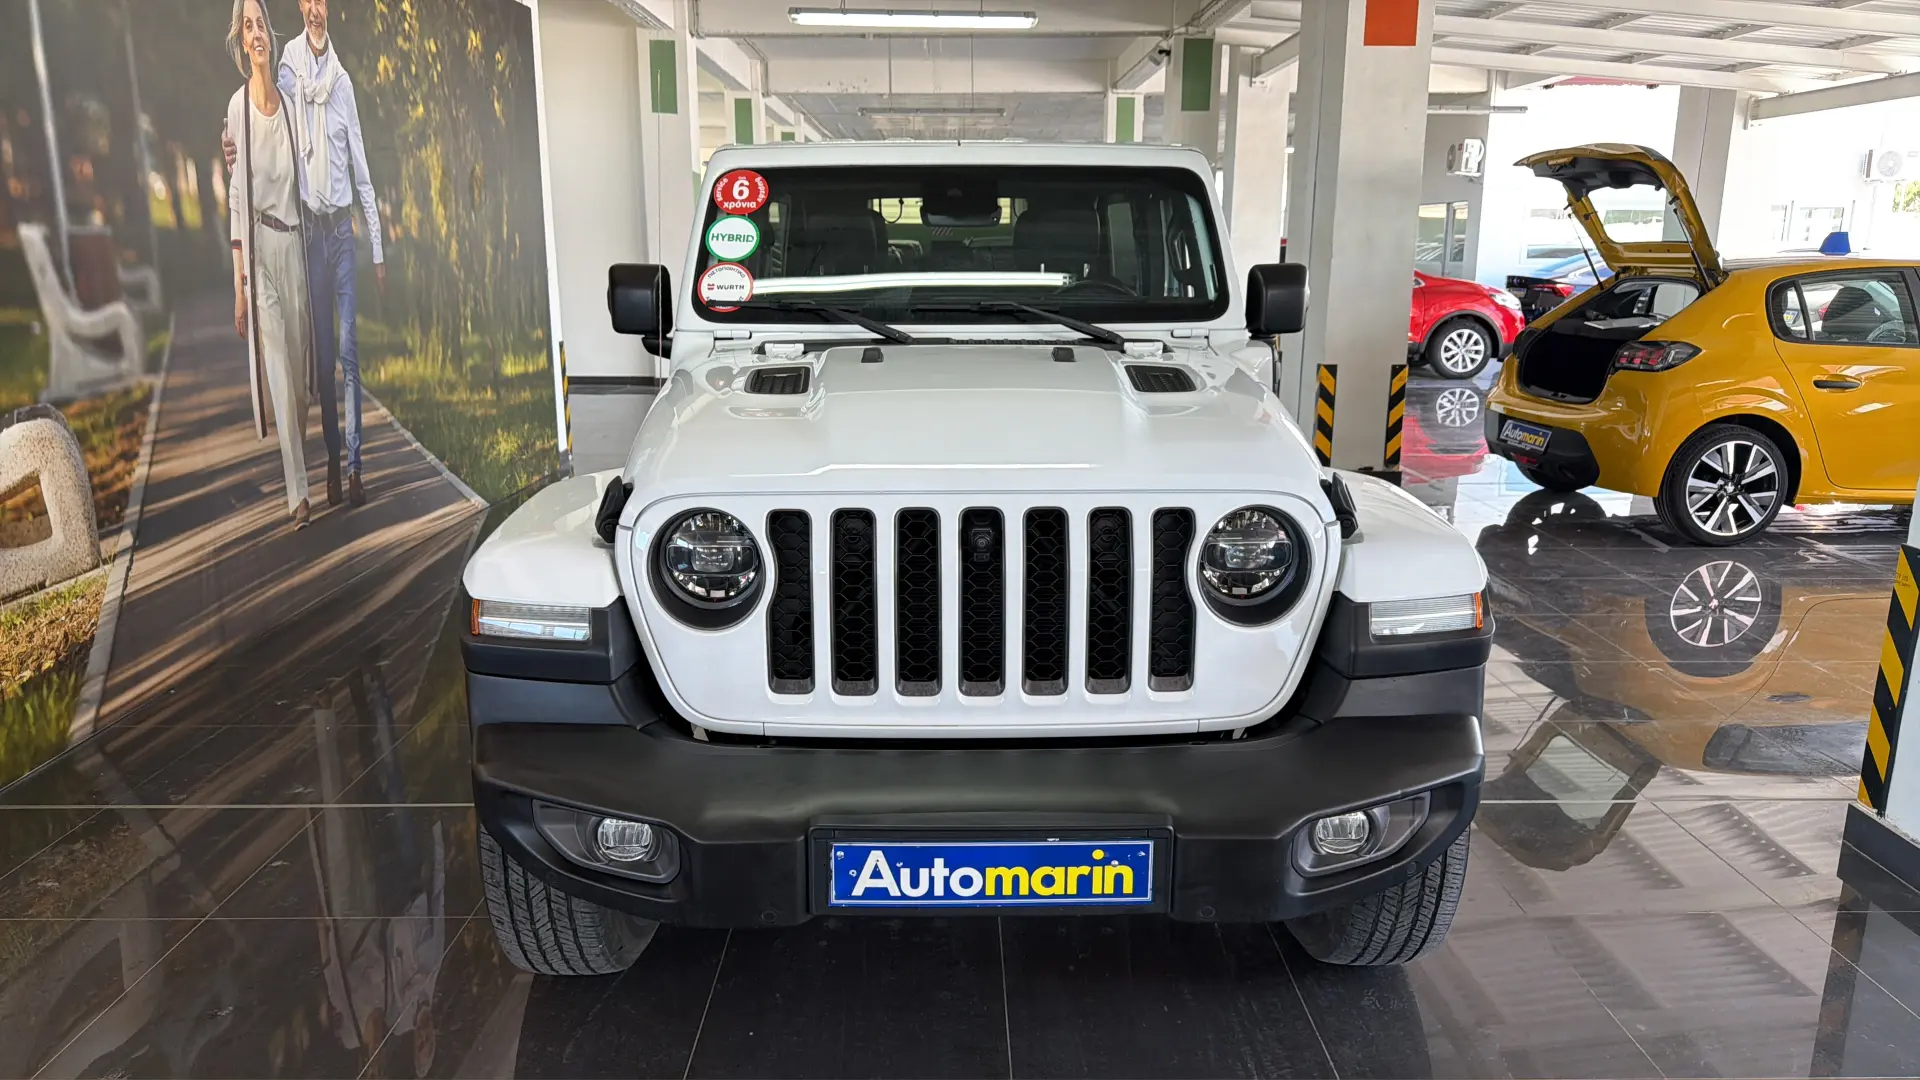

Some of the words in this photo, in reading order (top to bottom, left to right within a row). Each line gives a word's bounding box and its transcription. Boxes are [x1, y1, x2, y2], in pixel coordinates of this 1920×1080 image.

[732, 179, 750, 200] 6
[723, 200, 757, 210] χρόνια
[710, 232, 755, 243] HYBRID
[1503, 423, 1545, 447] Automarin
[851, 849, 1134, 897] Automarin
